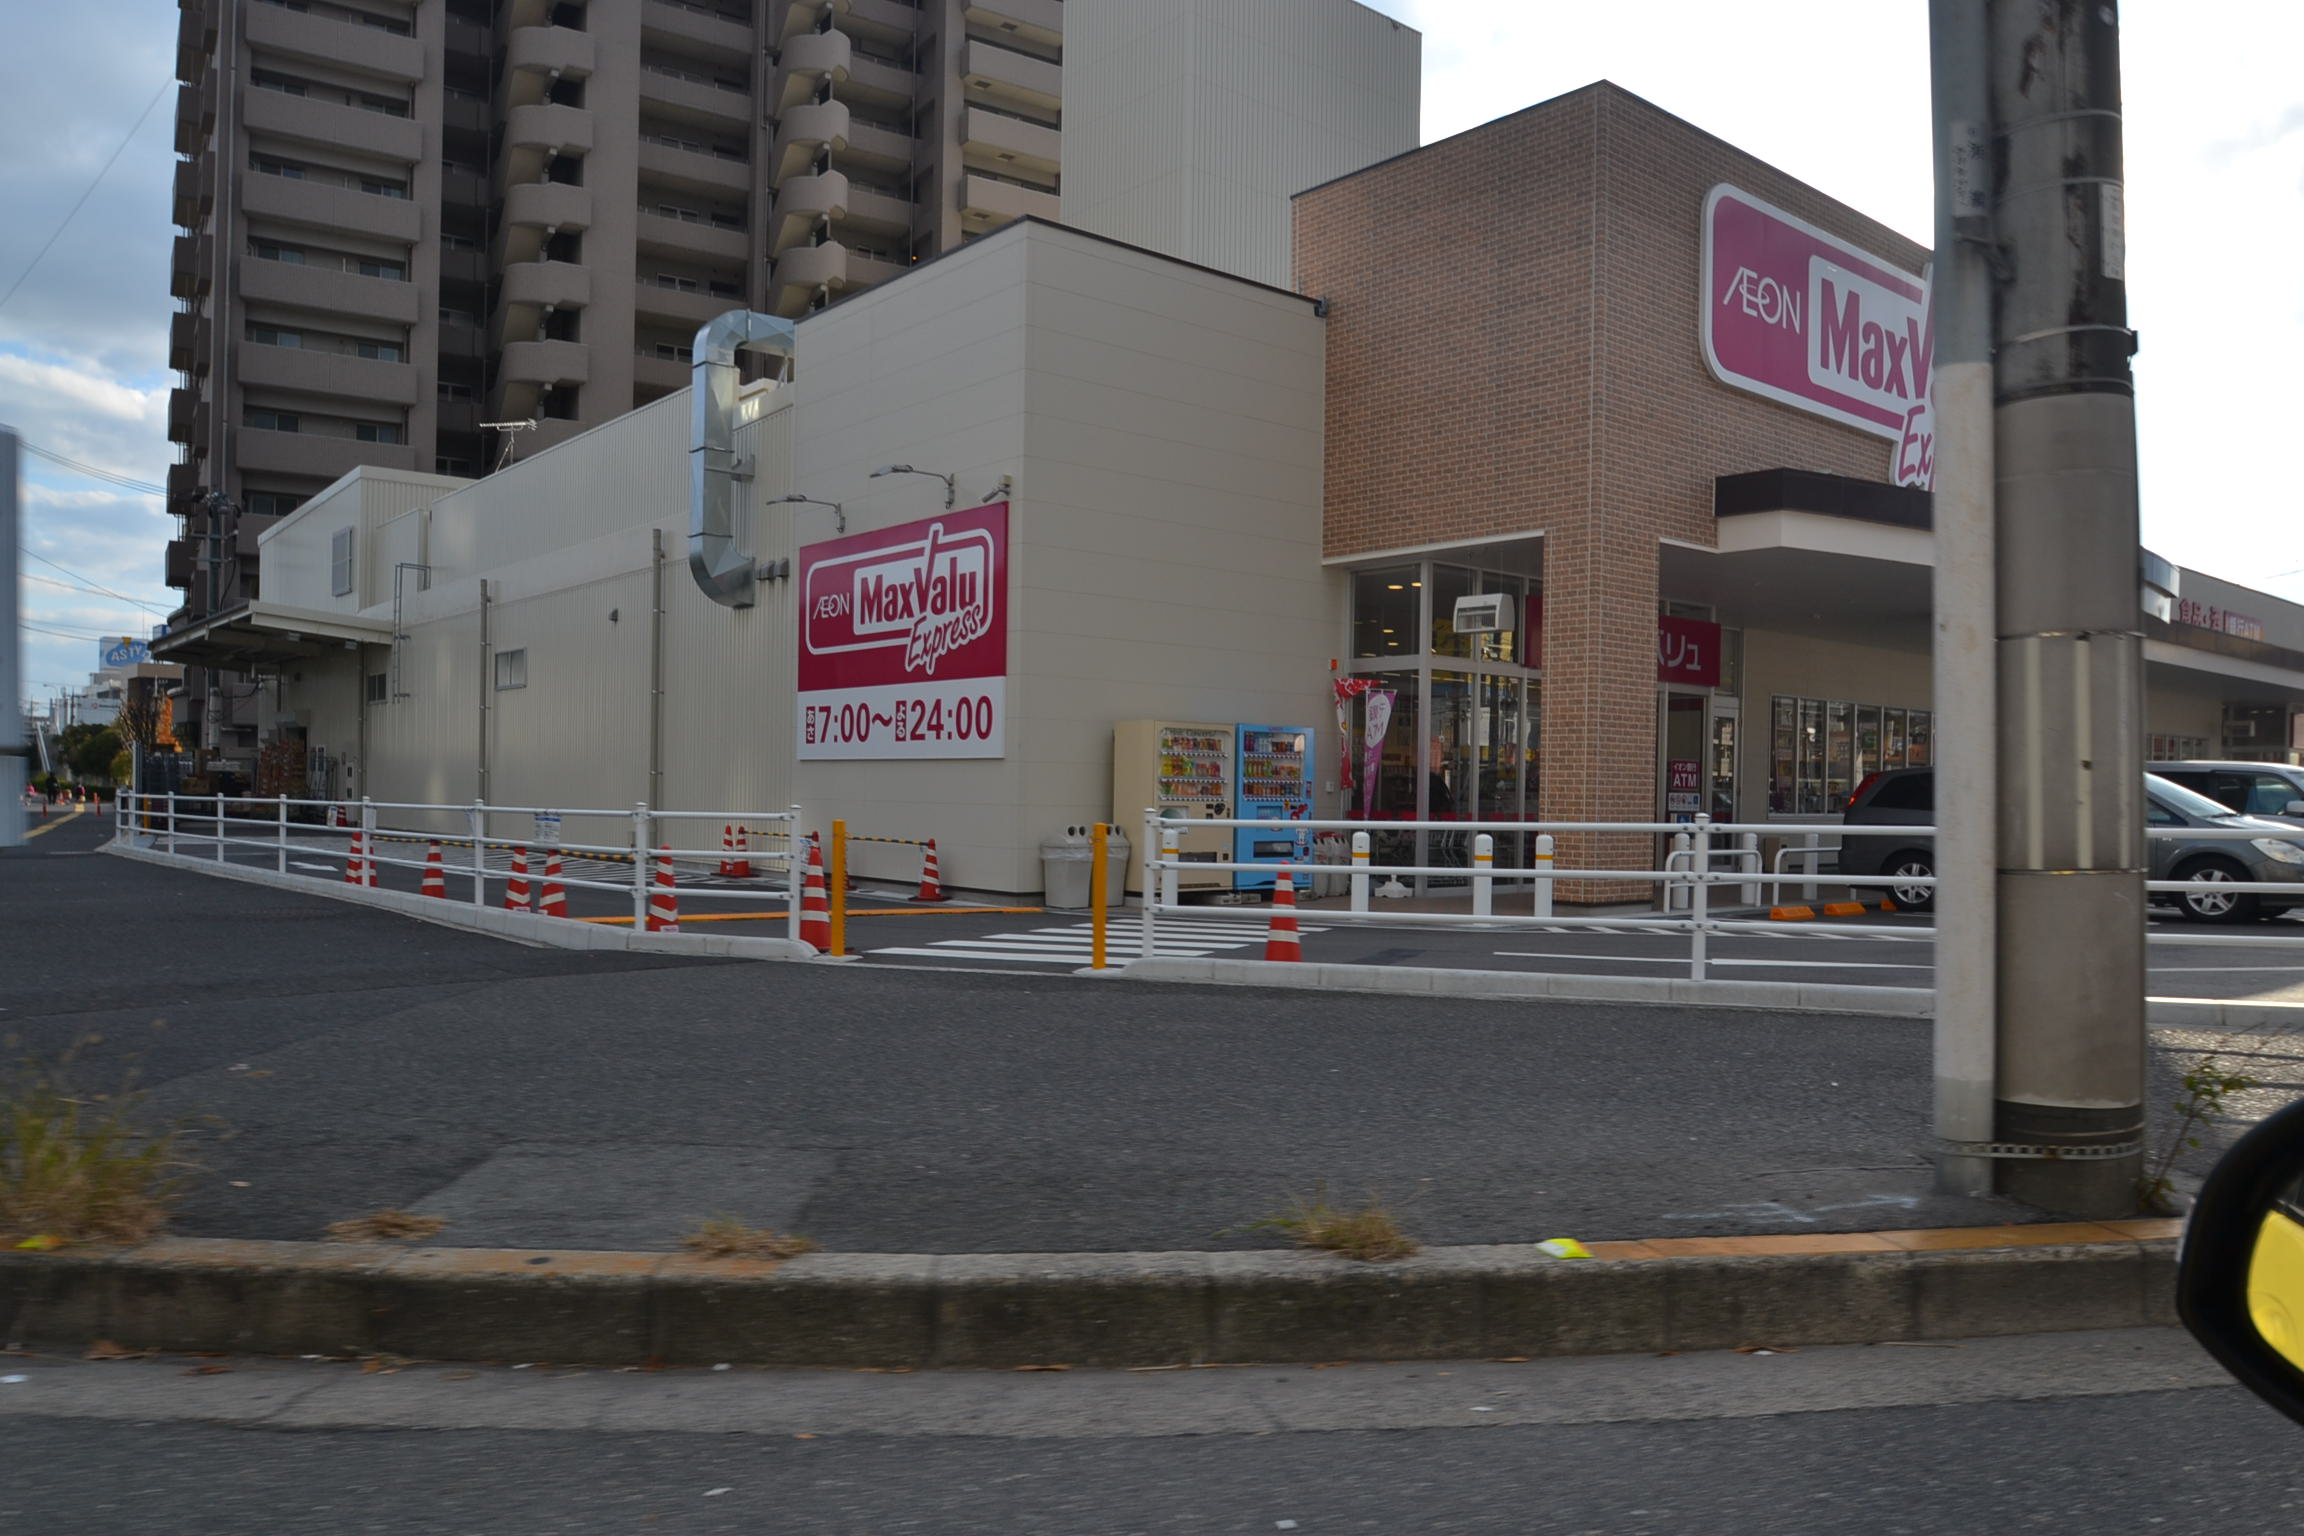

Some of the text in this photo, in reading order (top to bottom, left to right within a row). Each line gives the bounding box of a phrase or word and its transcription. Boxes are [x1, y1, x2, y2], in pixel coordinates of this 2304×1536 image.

[860, 529, 977, 625] MaxValu
[111, 645, 142, 662] ASTY
[908, 603, 981, 672] Express
[1673, 773, 1697, 788] ATM
